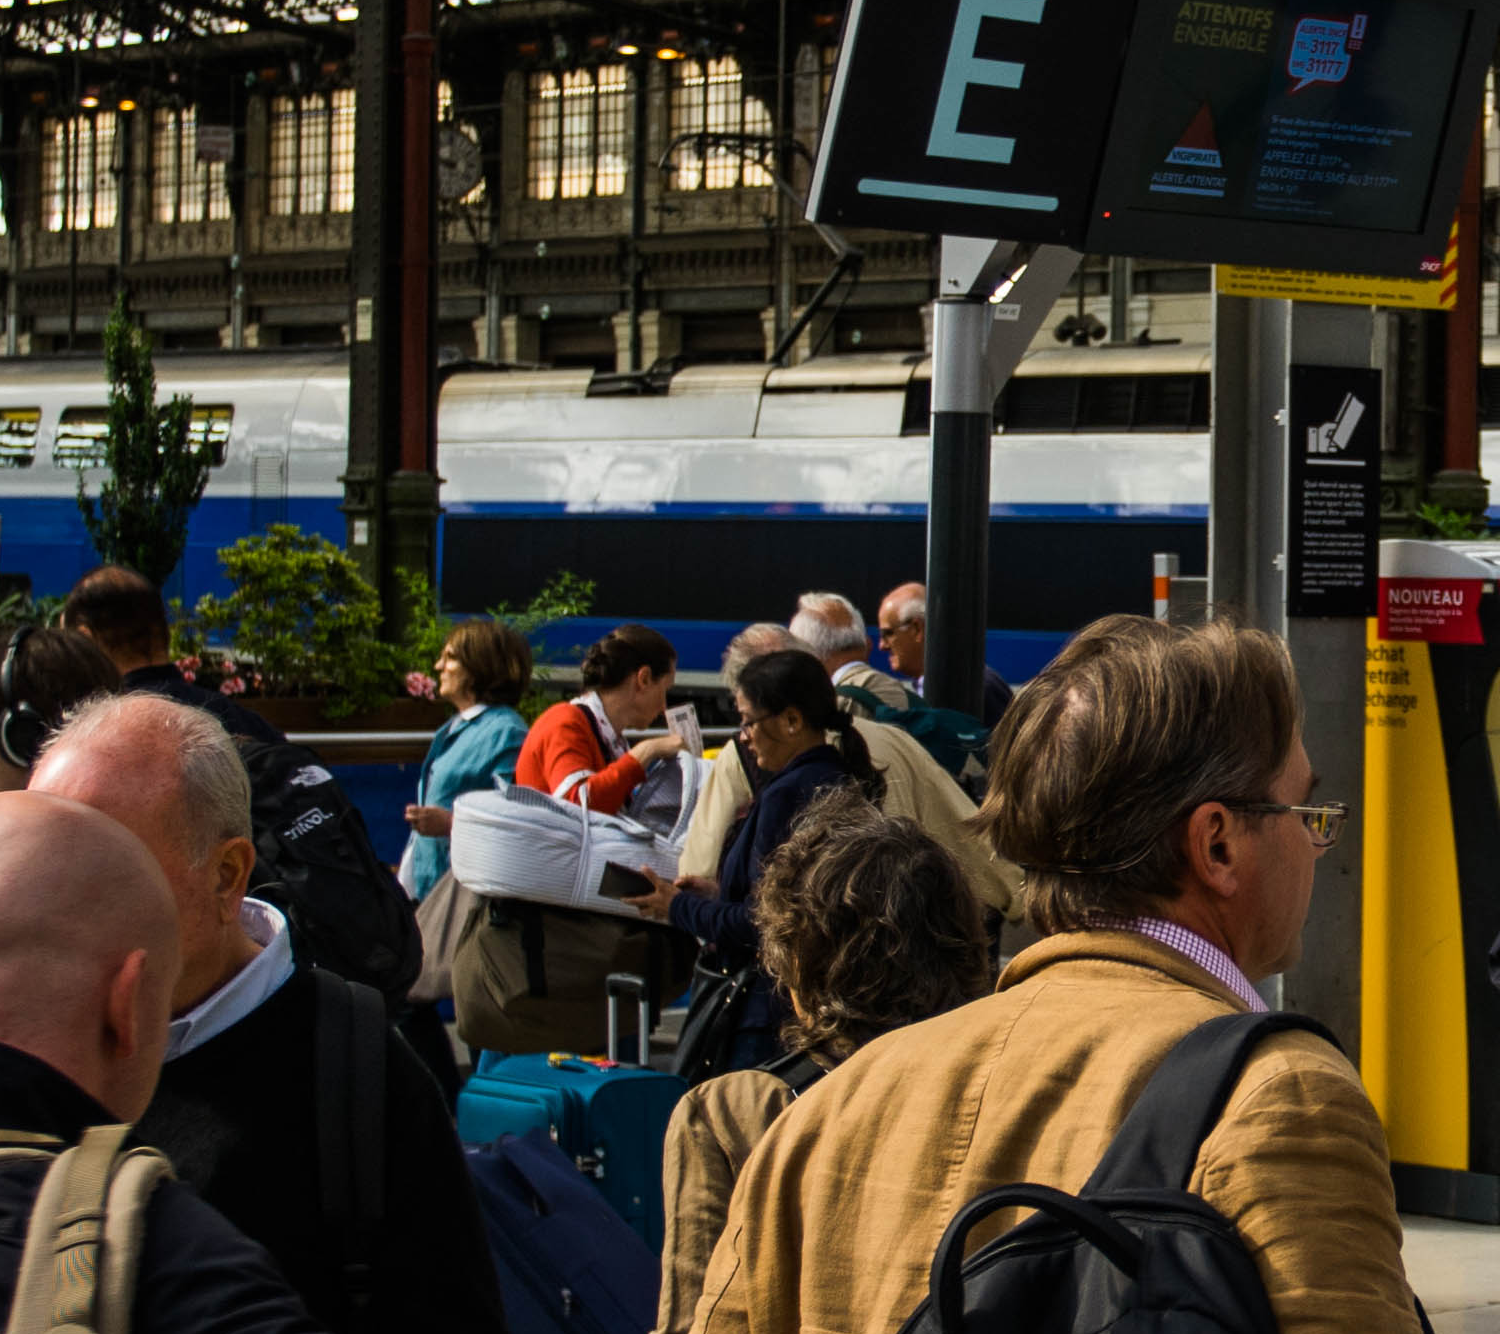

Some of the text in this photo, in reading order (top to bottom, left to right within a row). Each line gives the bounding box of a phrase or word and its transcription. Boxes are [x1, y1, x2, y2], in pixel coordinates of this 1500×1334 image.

[1177, 0, 1274, 31] ATTENTIFS
[1172, 23, 1268, 53] ENSEMBLE
[1308, 39, 1341, 55] 3117
[1387, 588, 1464, 606] NOUVEAU
